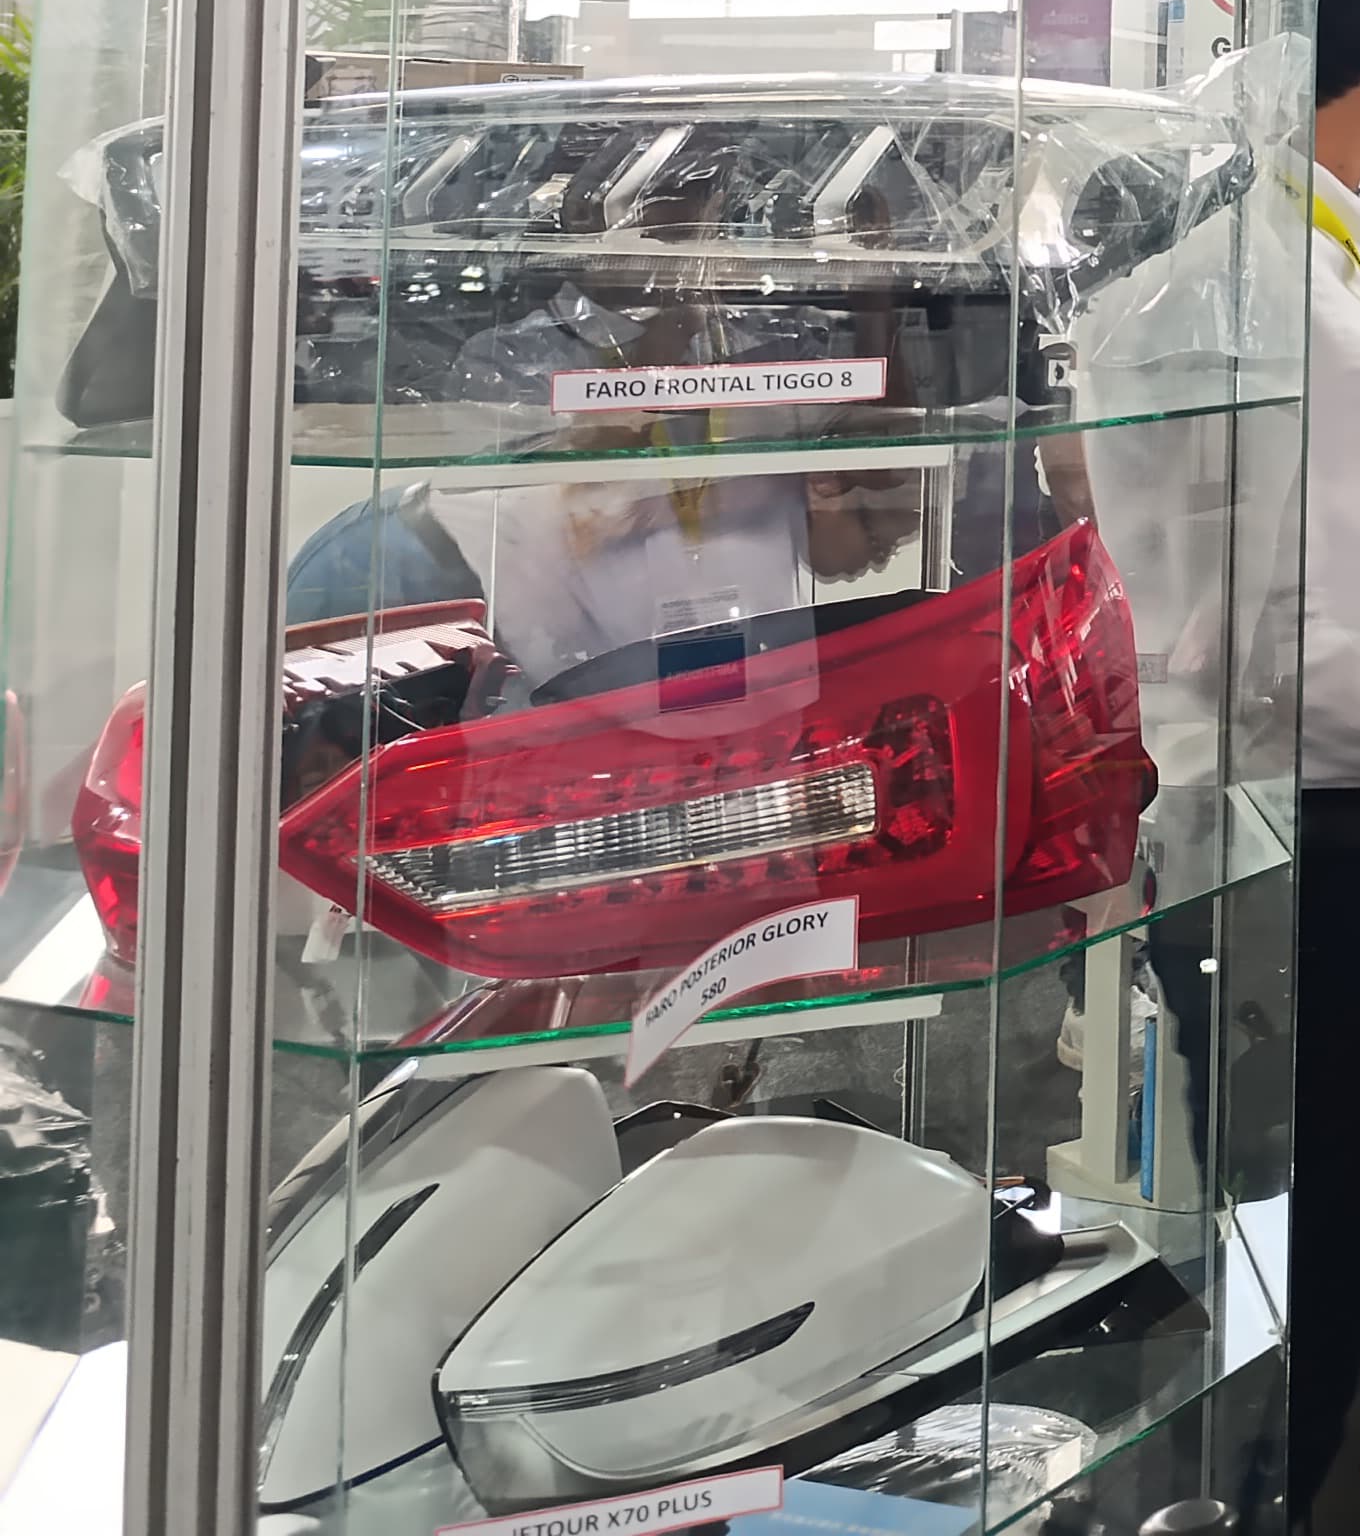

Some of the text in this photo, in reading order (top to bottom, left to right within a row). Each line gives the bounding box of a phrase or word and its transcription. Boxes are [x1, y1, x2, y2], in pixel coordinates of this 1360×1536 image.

[585, 370, 852, 399] FARO FRONTAL TIGGO 8
[680, 932, 757, 1000] POSTERIOR
[761, 911, 829, 943] GLORY
[700, 976, 727, 1007] 580
[607, 1504, 650, 1529] X70
[657, 1489, 713, 1518] PLUS
